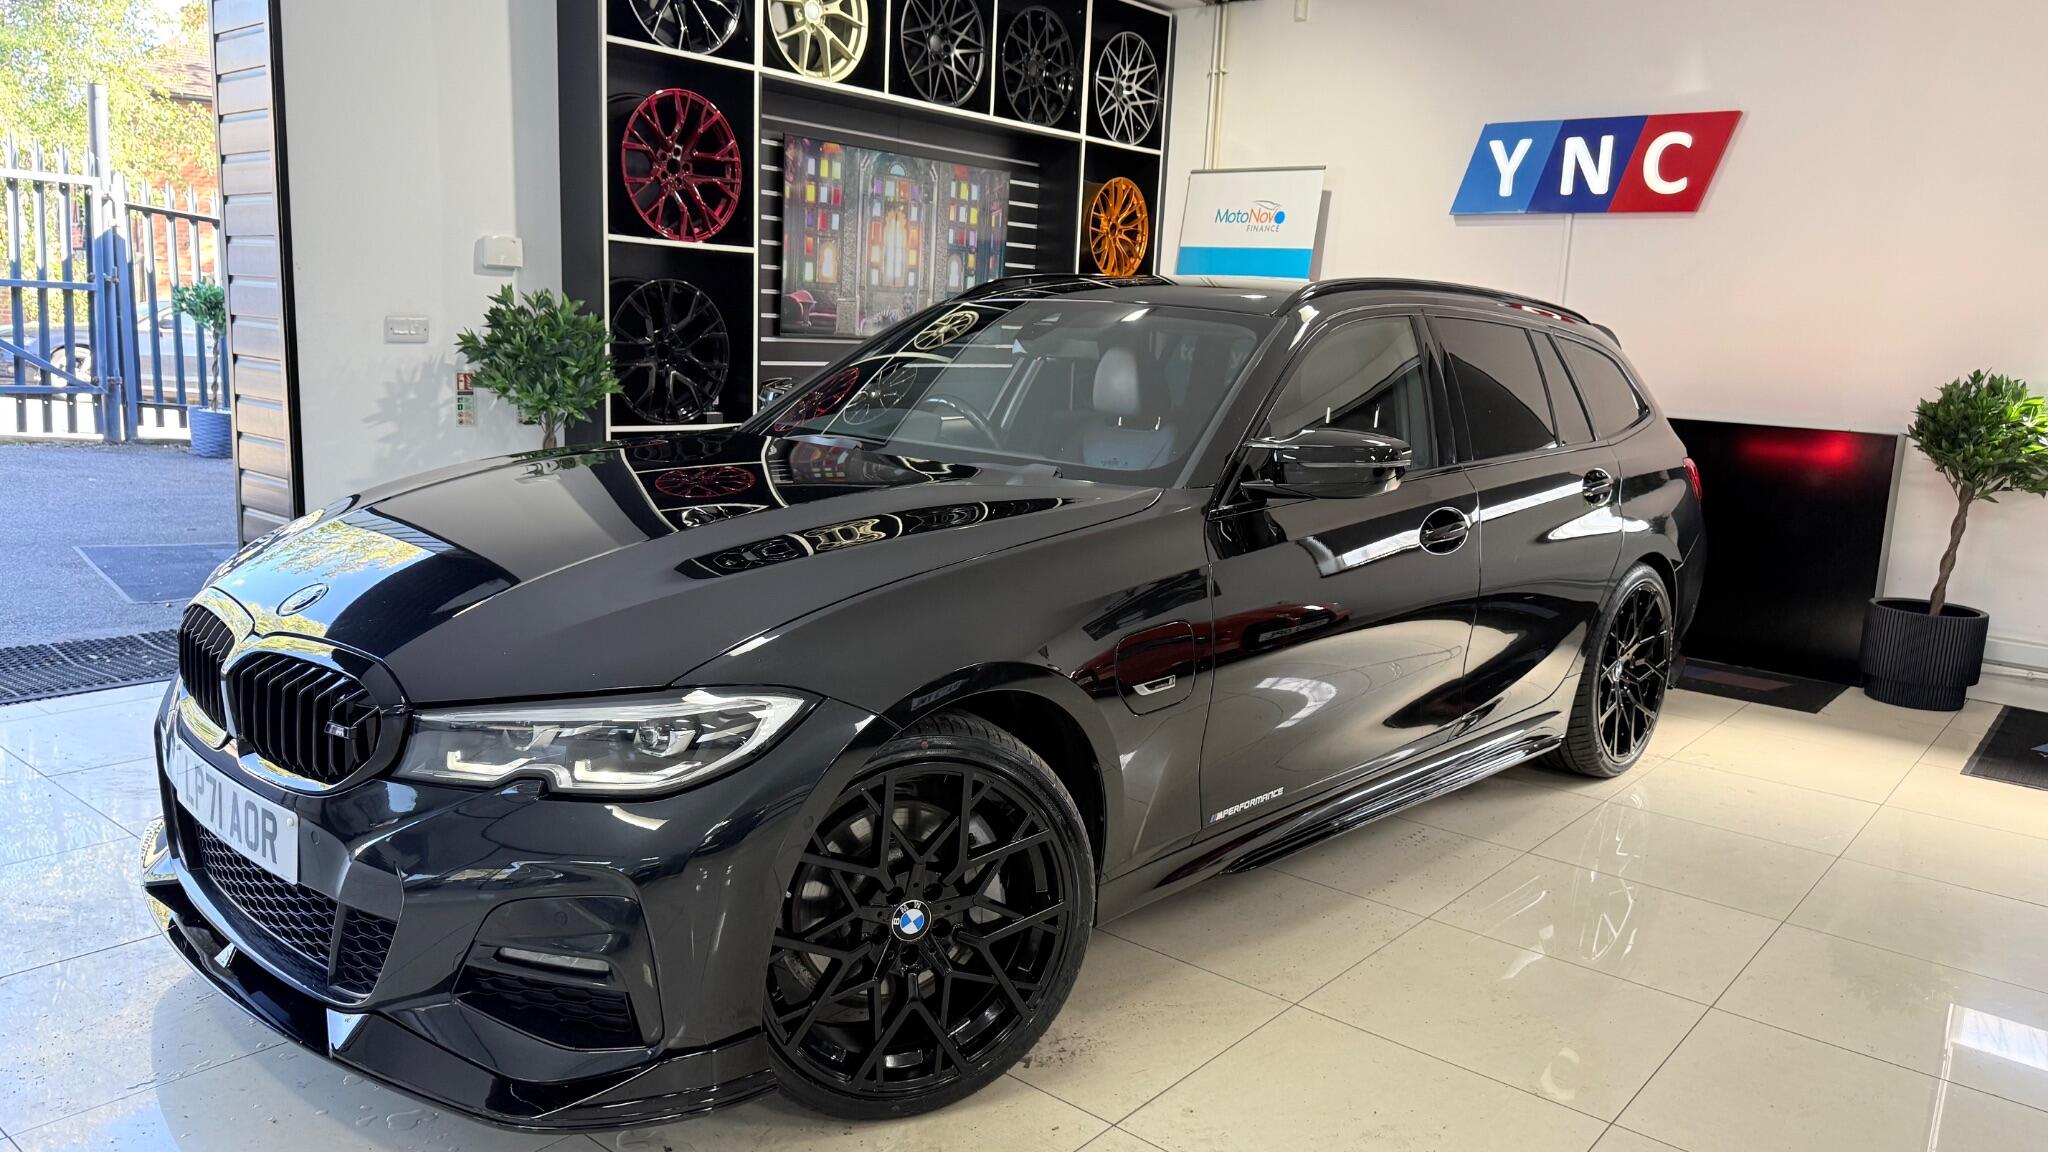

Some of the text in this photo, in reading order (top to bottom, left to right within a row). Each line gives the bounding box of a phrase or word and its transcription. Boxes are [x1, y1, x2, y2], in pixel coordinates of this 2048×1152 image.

[1489, 131, 1693, 197] YNC
[1215, 207, 1285, 224] MotoNovo
[185, 754, 278, 865] LP71 AOR
[892, 900, 922, 926] BMW
